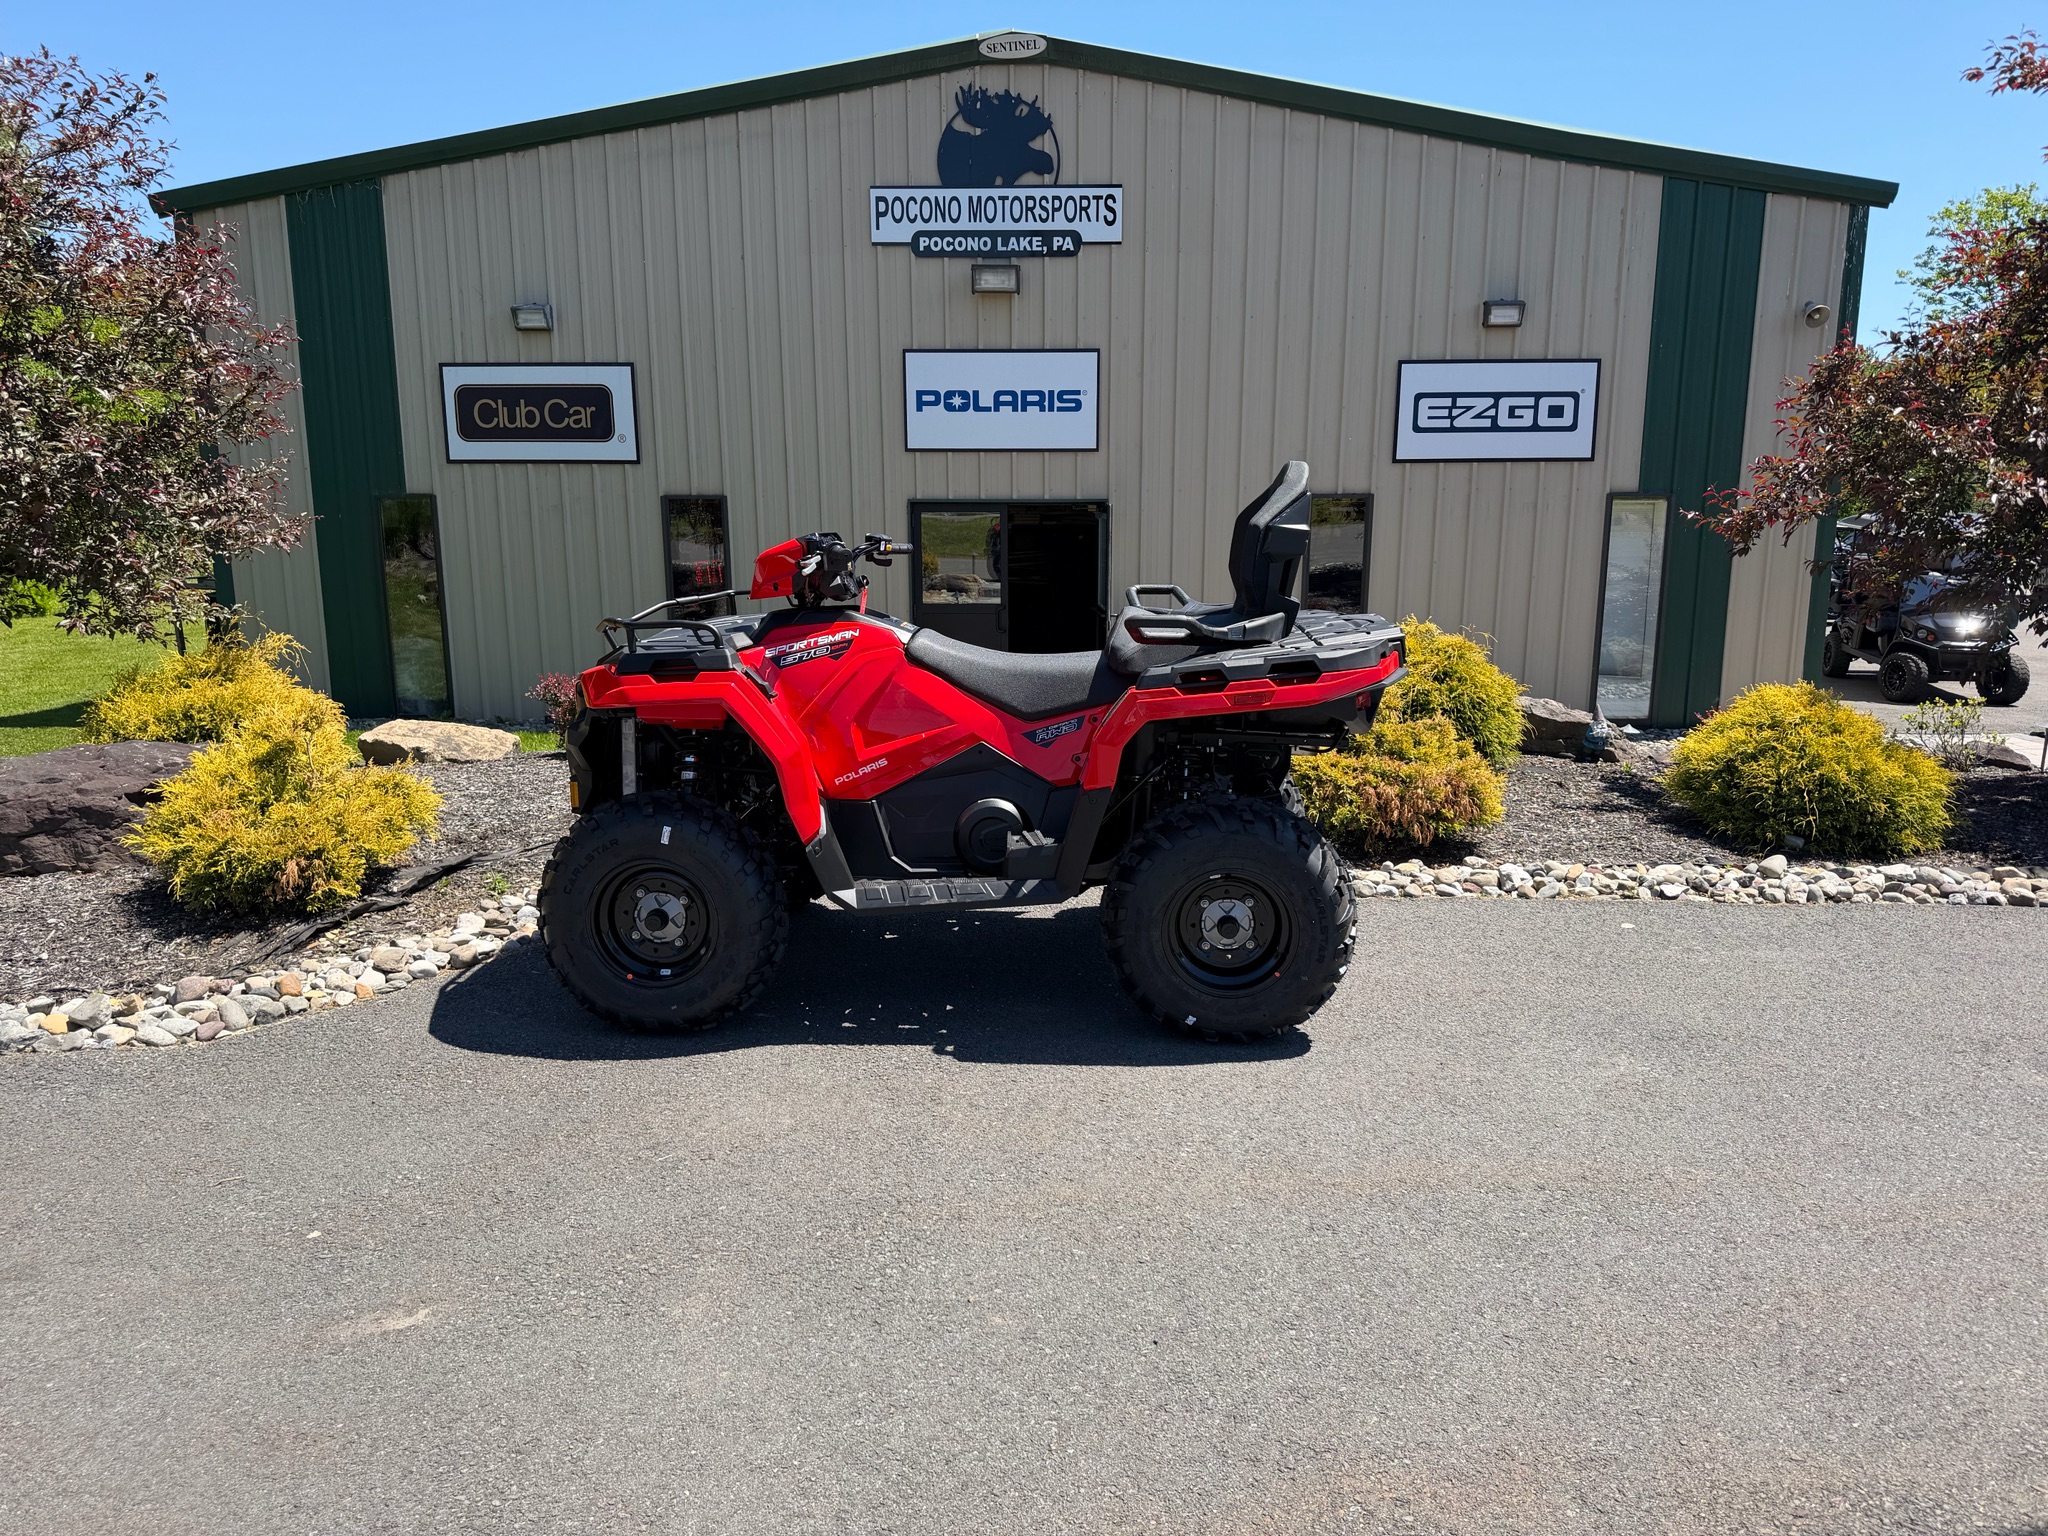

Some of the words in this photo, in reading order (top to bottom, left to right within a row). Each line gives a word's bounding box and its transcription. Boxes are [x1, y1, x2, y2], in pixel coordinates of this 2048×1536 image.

[986, 39, 1040, 54] SENTINEL
[875, 195, 962, 230] POCONO
[968, 193, 1117, 227] MOTORSPORTS
[919, 236, 992, 251] POCONO
[997, 236, 1048, 254] LAKE,
[1053, 236, 1074, 251] PA
[473, 398, 541, 429] Club
[544, 398, 596, 429] Car
[915, 389, 1083, 413] POLARIS
[765, 628, 860, 658] SPORTSMAN
[780, 645, 831, 666] 570
[1035, 722, 1078, 742] AWD
[834, 757, 888, 786] POLARIS
[563, 838, 620, 896] CARLSTAR
